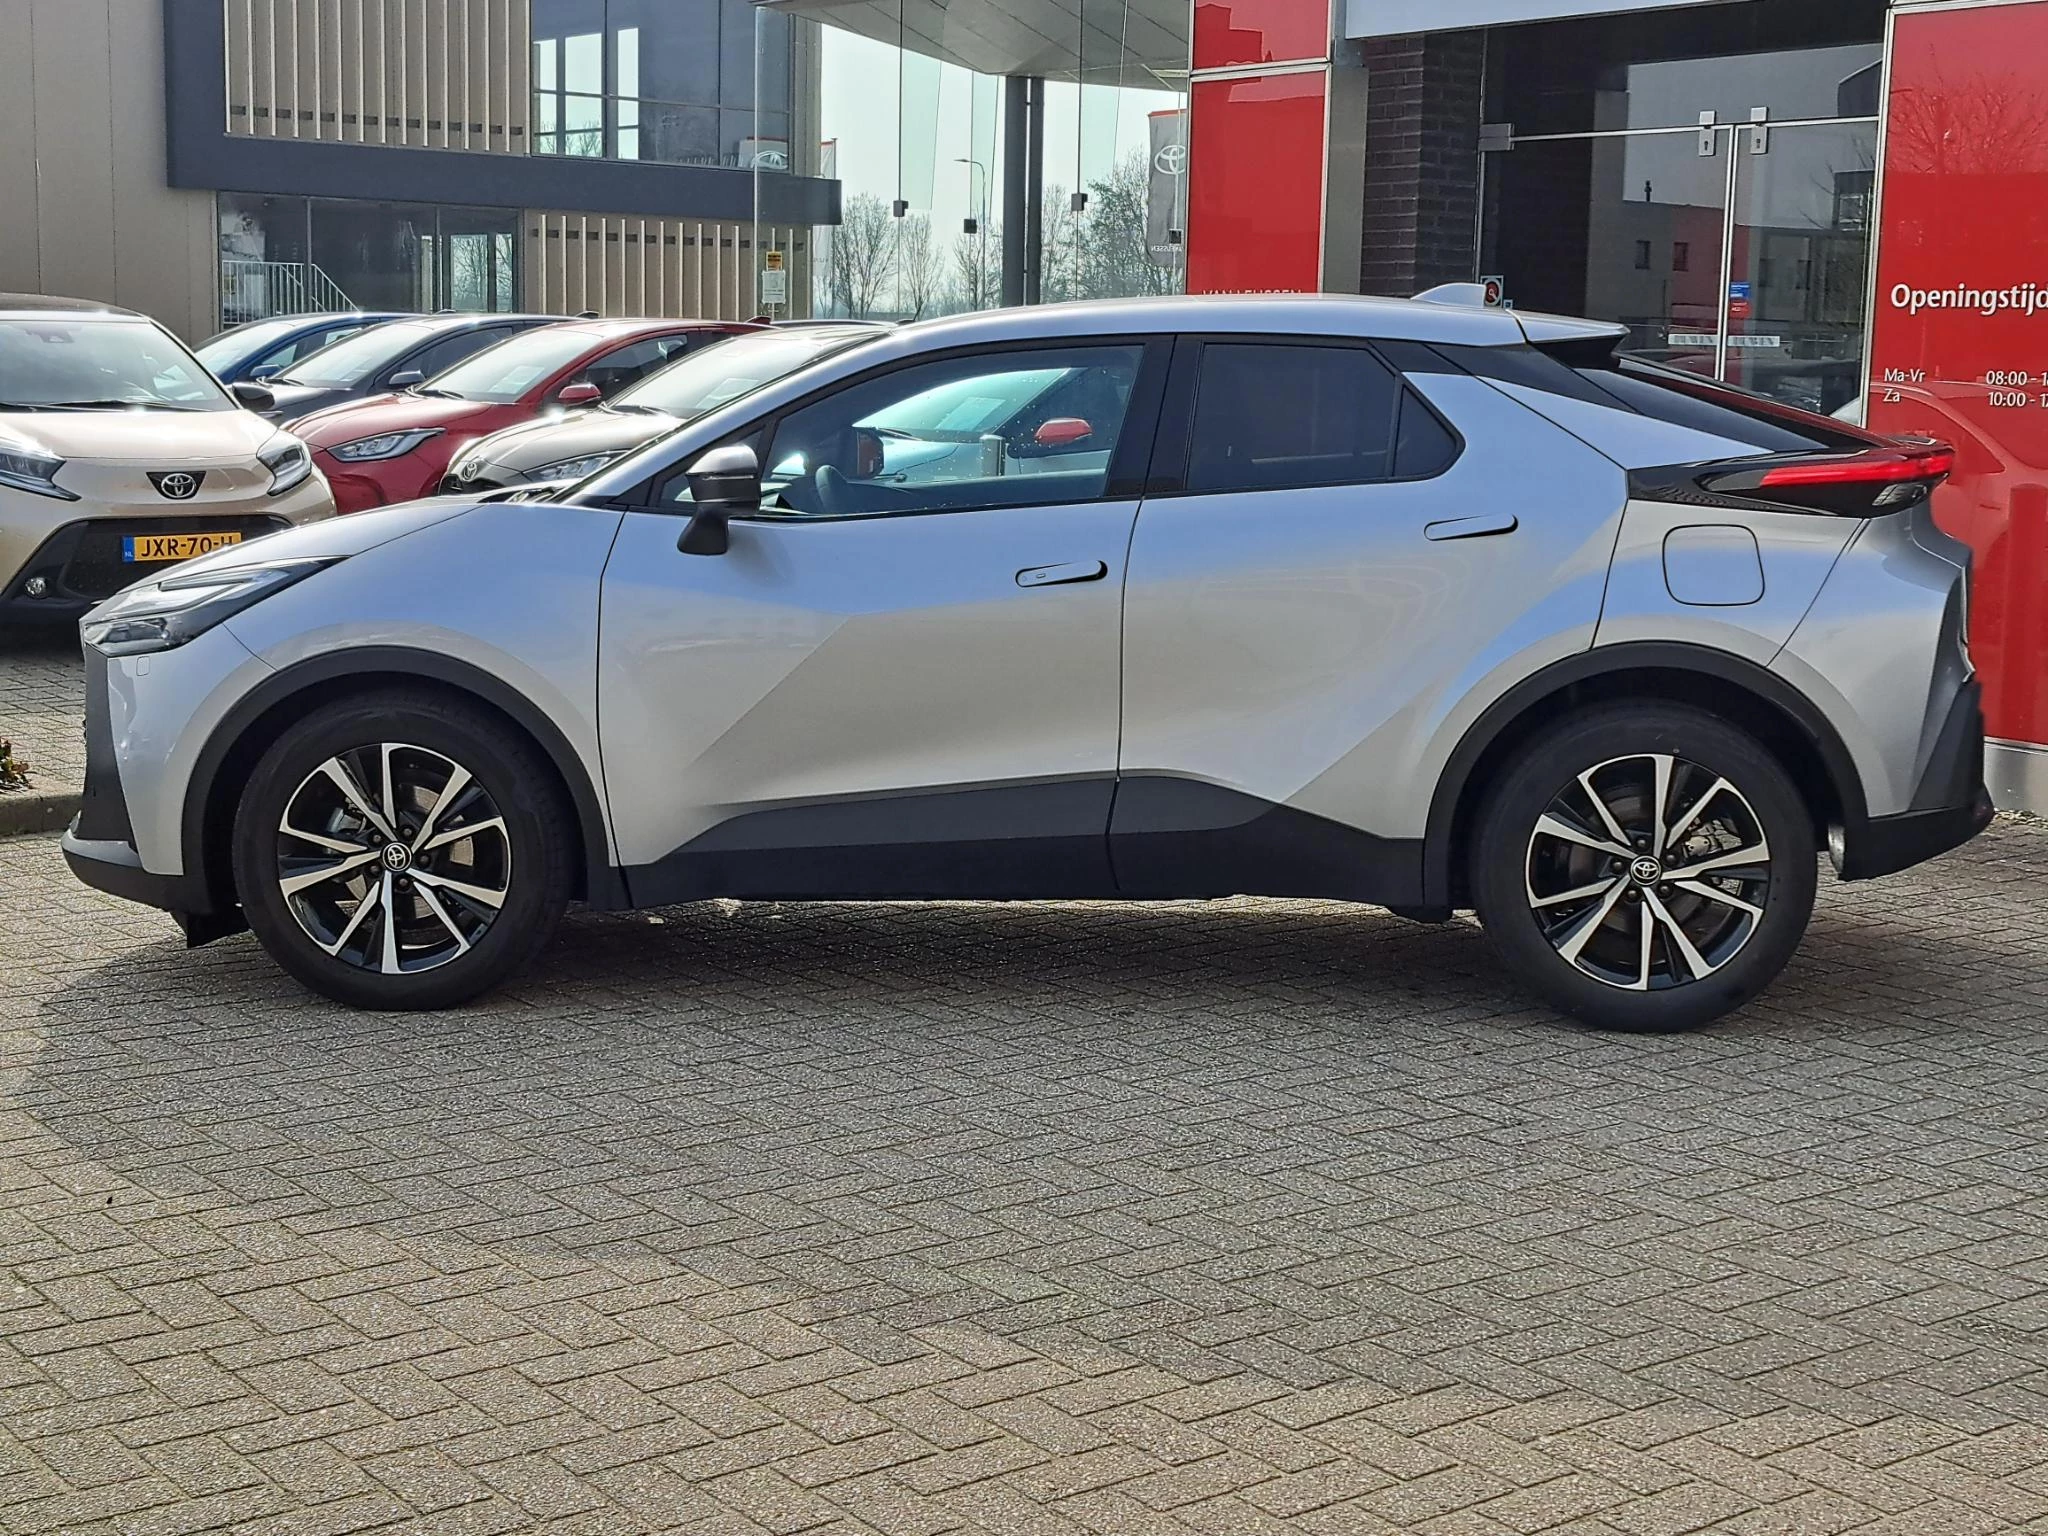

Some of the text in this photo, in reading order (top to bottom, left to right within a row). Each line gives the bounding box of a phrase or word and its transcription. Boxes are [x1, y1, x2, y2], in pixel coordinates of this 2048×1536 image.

[1890, 283, 2048, 316] Openingstijd
[1883, 367, 1926, 383] Ma-Vr
[1985, 370, 2028, 386] 08:00
[2040, 371, 2048, 387] 1
[1882, 388, 1901, 402] Za
[1987, 391, 2027, 407] 10:00
[2039, 392, 2048, 408] 1
